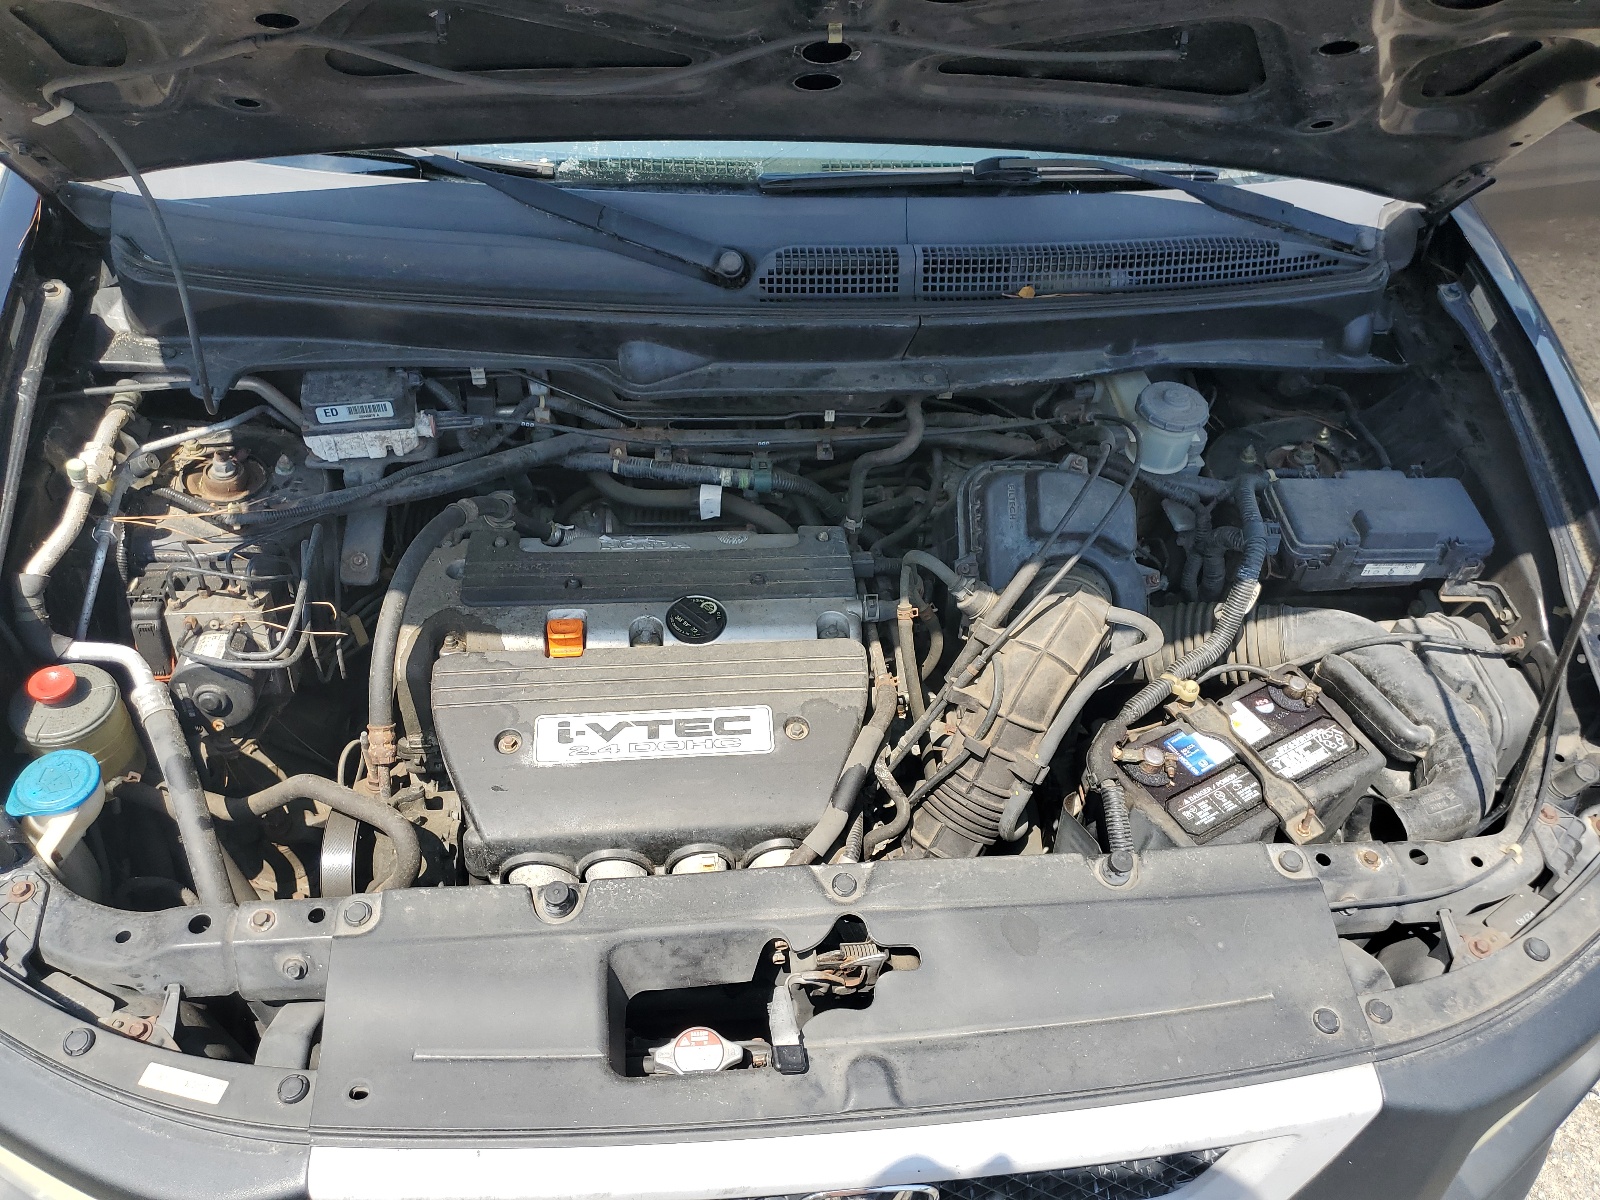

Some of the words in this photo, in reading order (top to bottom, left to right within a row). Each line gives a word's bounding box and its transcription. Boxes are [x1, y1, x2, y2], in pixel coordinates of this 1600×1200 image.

[323, 408, 339, 418] ED
[557, 715, 752, 744] i-VTEC
[568, 743, 621, 757] 2.4
[628, 738, 742, 753] DOHC
[1188, 784, 1213, 802] DANGER
[1215, 772, 1238, 788] POISON
